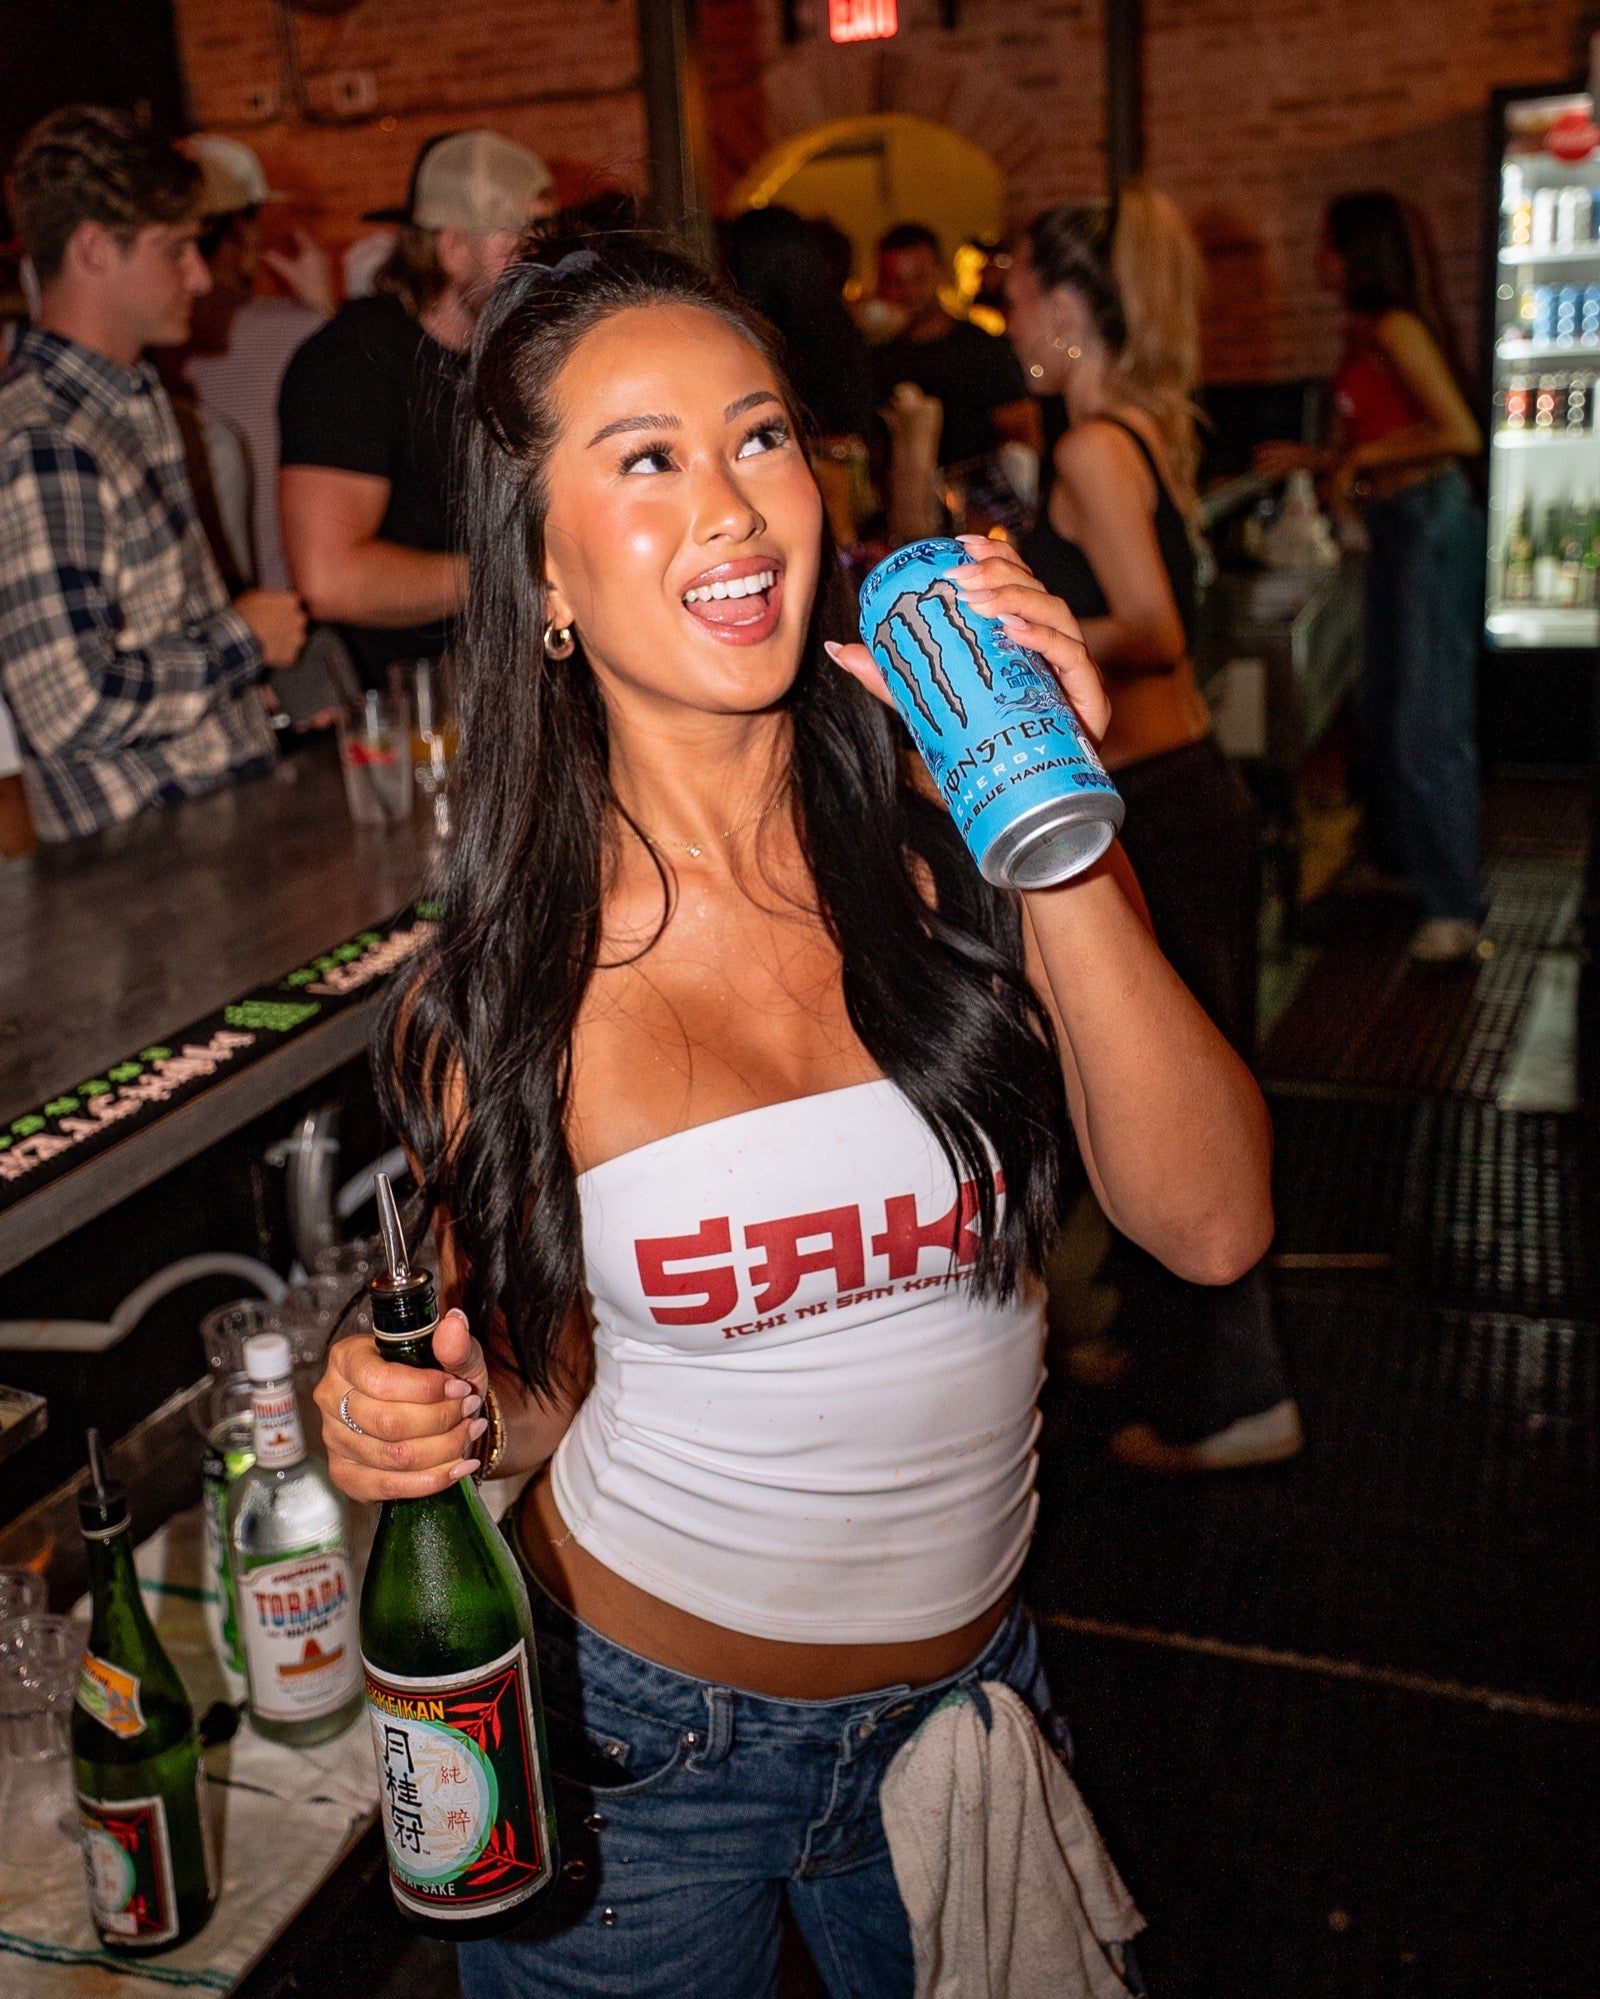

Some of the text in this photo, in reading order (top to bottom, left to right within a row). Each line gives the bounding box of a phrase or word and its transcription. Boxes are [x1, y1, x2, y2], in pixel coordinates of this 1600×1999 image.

[972, 783, 1007, 817] BLUE
[1009, 756, 1087, 785] HAWAIIAN
[633, 1170, 1007, 1327] SAK
[721, 1313, 788, 1340] ICHI
[794, 1302, 829, 1321] NI
[836, 1283, 894, 1311] SAN
[366, 1681, 445, 1721] EKKEIKAN
[421, 1880, 456, 1897] SAKE
